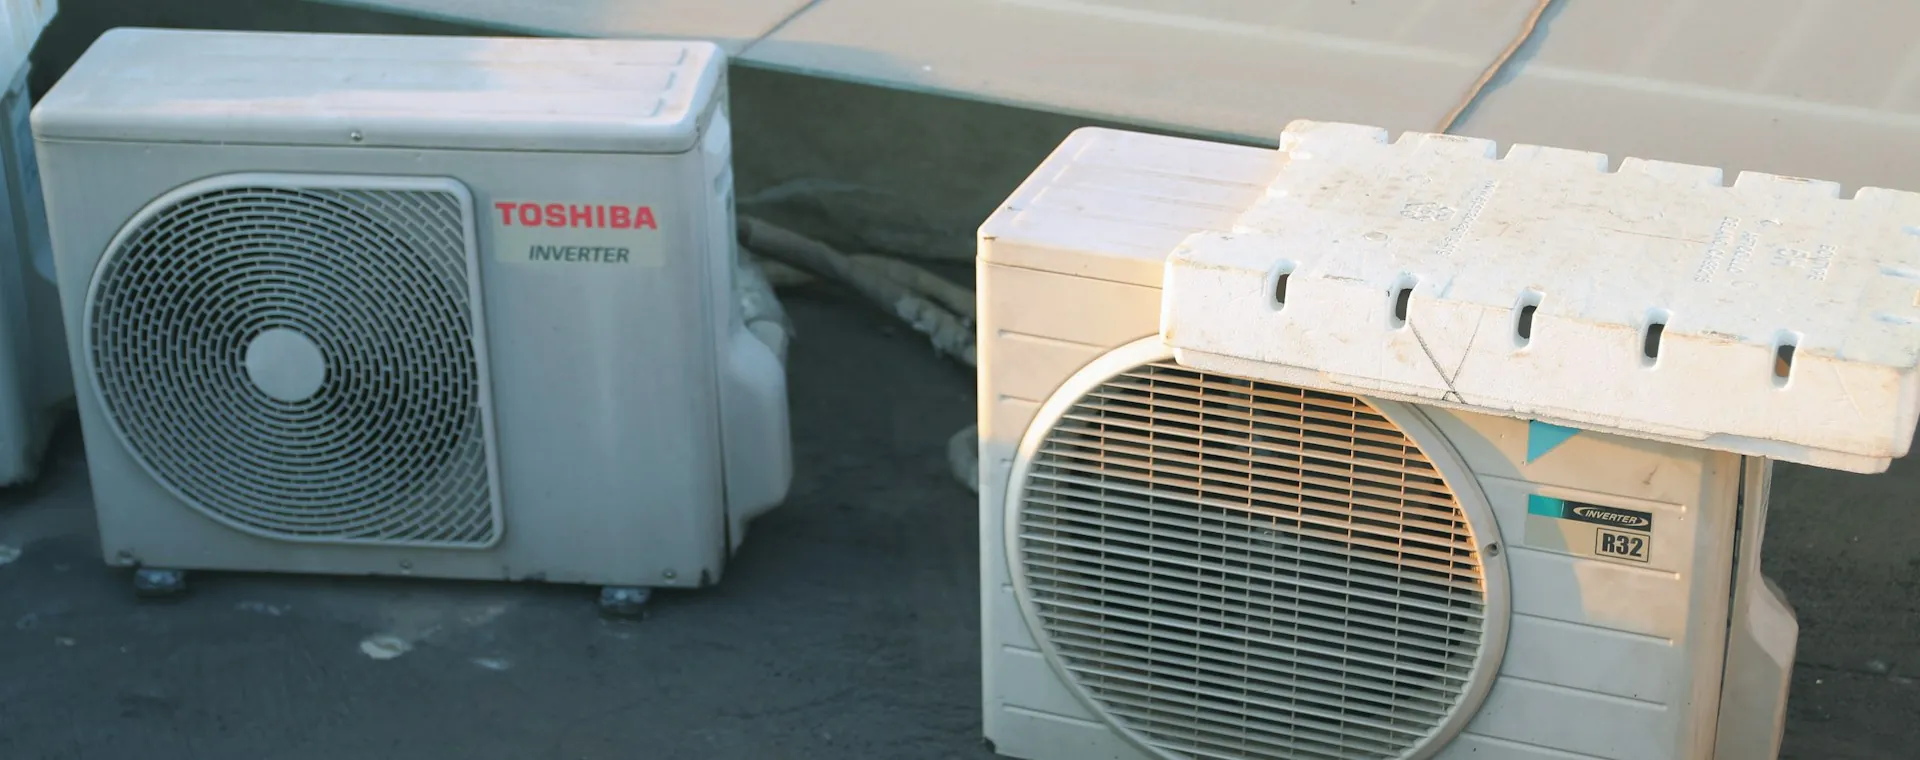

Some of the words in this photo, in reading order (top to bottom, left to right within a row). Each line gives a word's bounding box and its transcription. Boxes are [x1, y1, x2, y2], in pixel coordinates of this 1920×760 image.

[495, 202, 658, 230] TOSHIBA
[529, 245, 630, 264] INVERTER
[1585, 508, 1638, 525] INVERTER
[1602, 532, 1644, 557] R32
